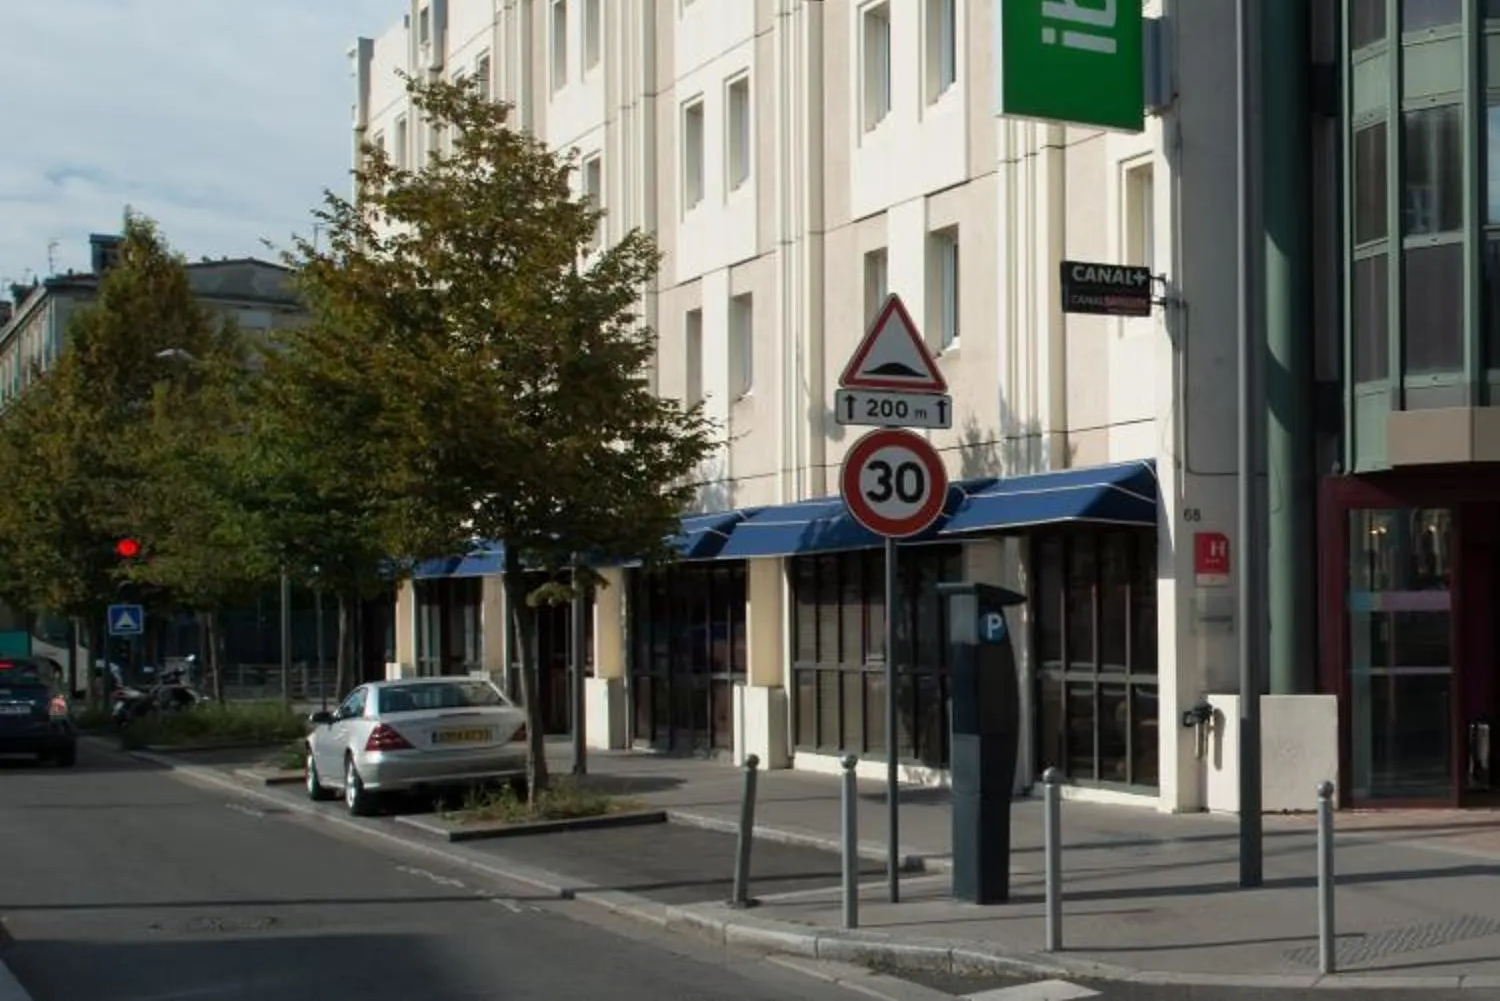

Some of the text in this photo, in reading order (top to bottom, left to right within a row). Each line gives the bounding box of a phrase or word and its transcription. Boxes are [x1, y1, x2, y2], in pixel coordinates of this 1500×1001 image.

[1071, 265, 1146, 286] CANAL+
[866, 398, 927, 420] 200 m
[866, 460, 925, 504] 30
[1210, 540, 1226, 556] H
[987, 614, 1003, 640] P
